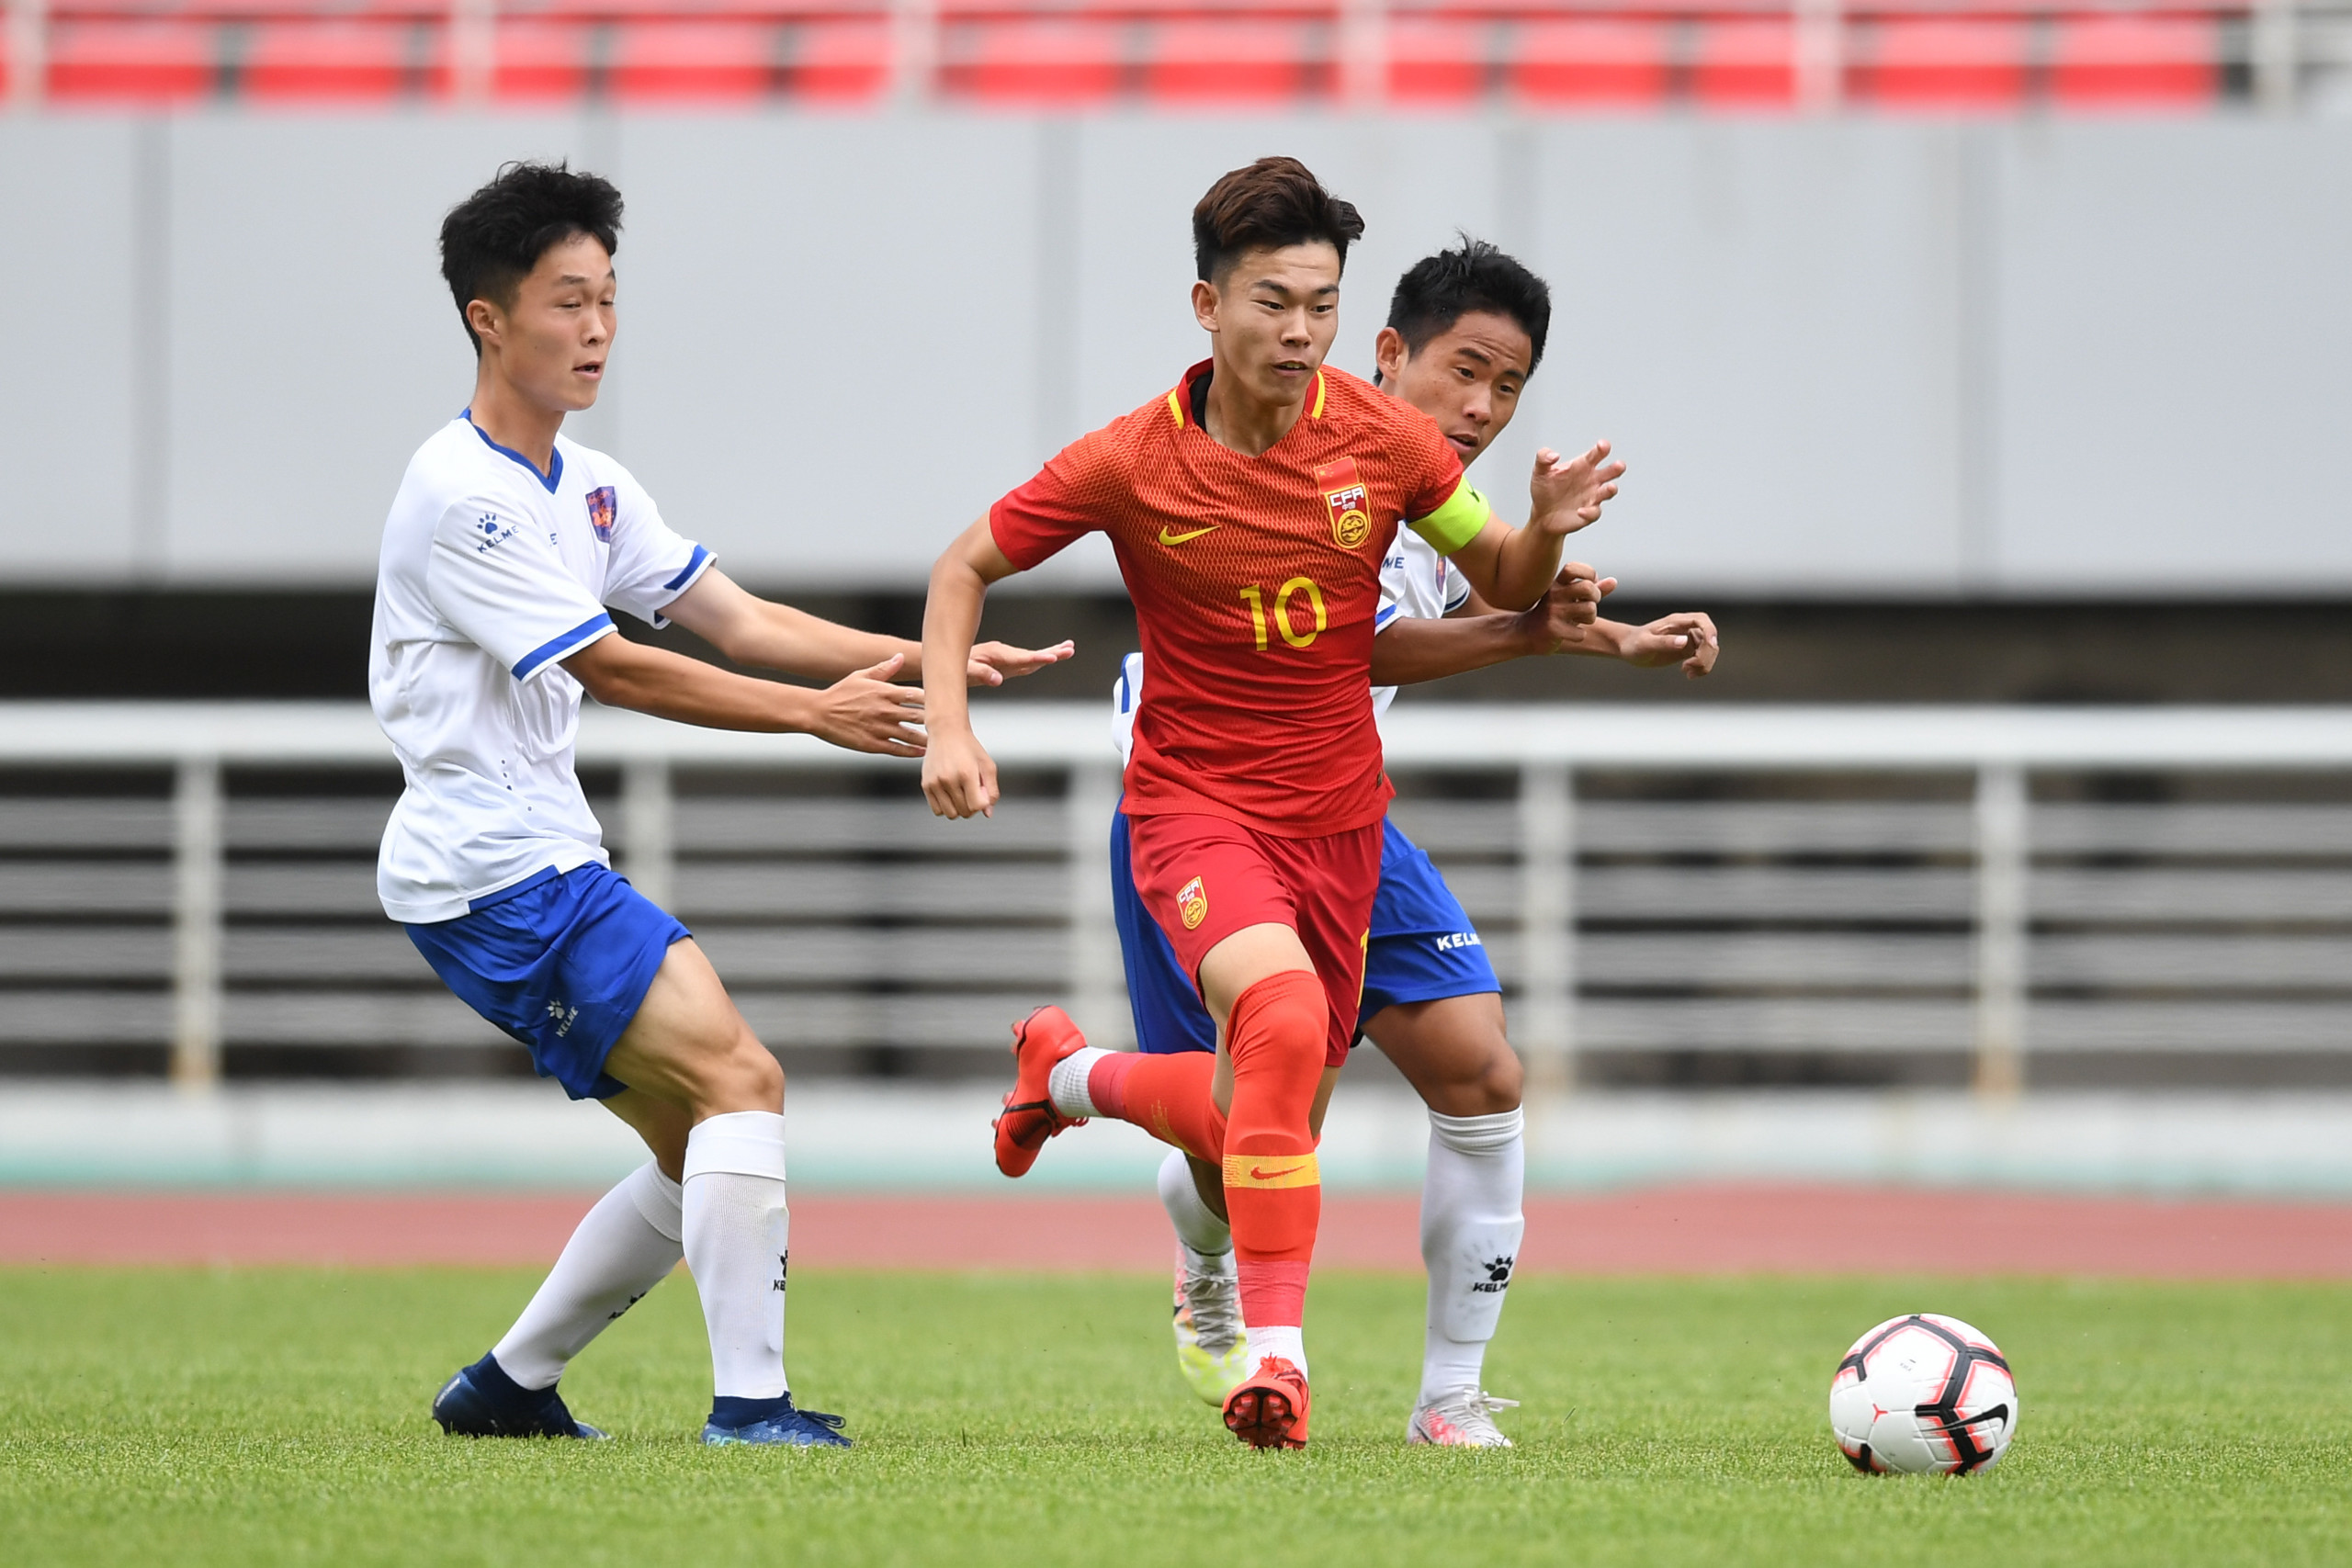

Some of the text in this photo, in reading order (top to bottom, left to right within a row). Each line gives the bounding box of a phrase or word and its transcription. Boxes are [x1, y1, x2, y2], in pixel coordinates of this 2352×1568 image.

[1329, 486, 1364, 507] CFA
[477, 525, 519, 553] KELME
[1240, 577, 1327, 651] 10
